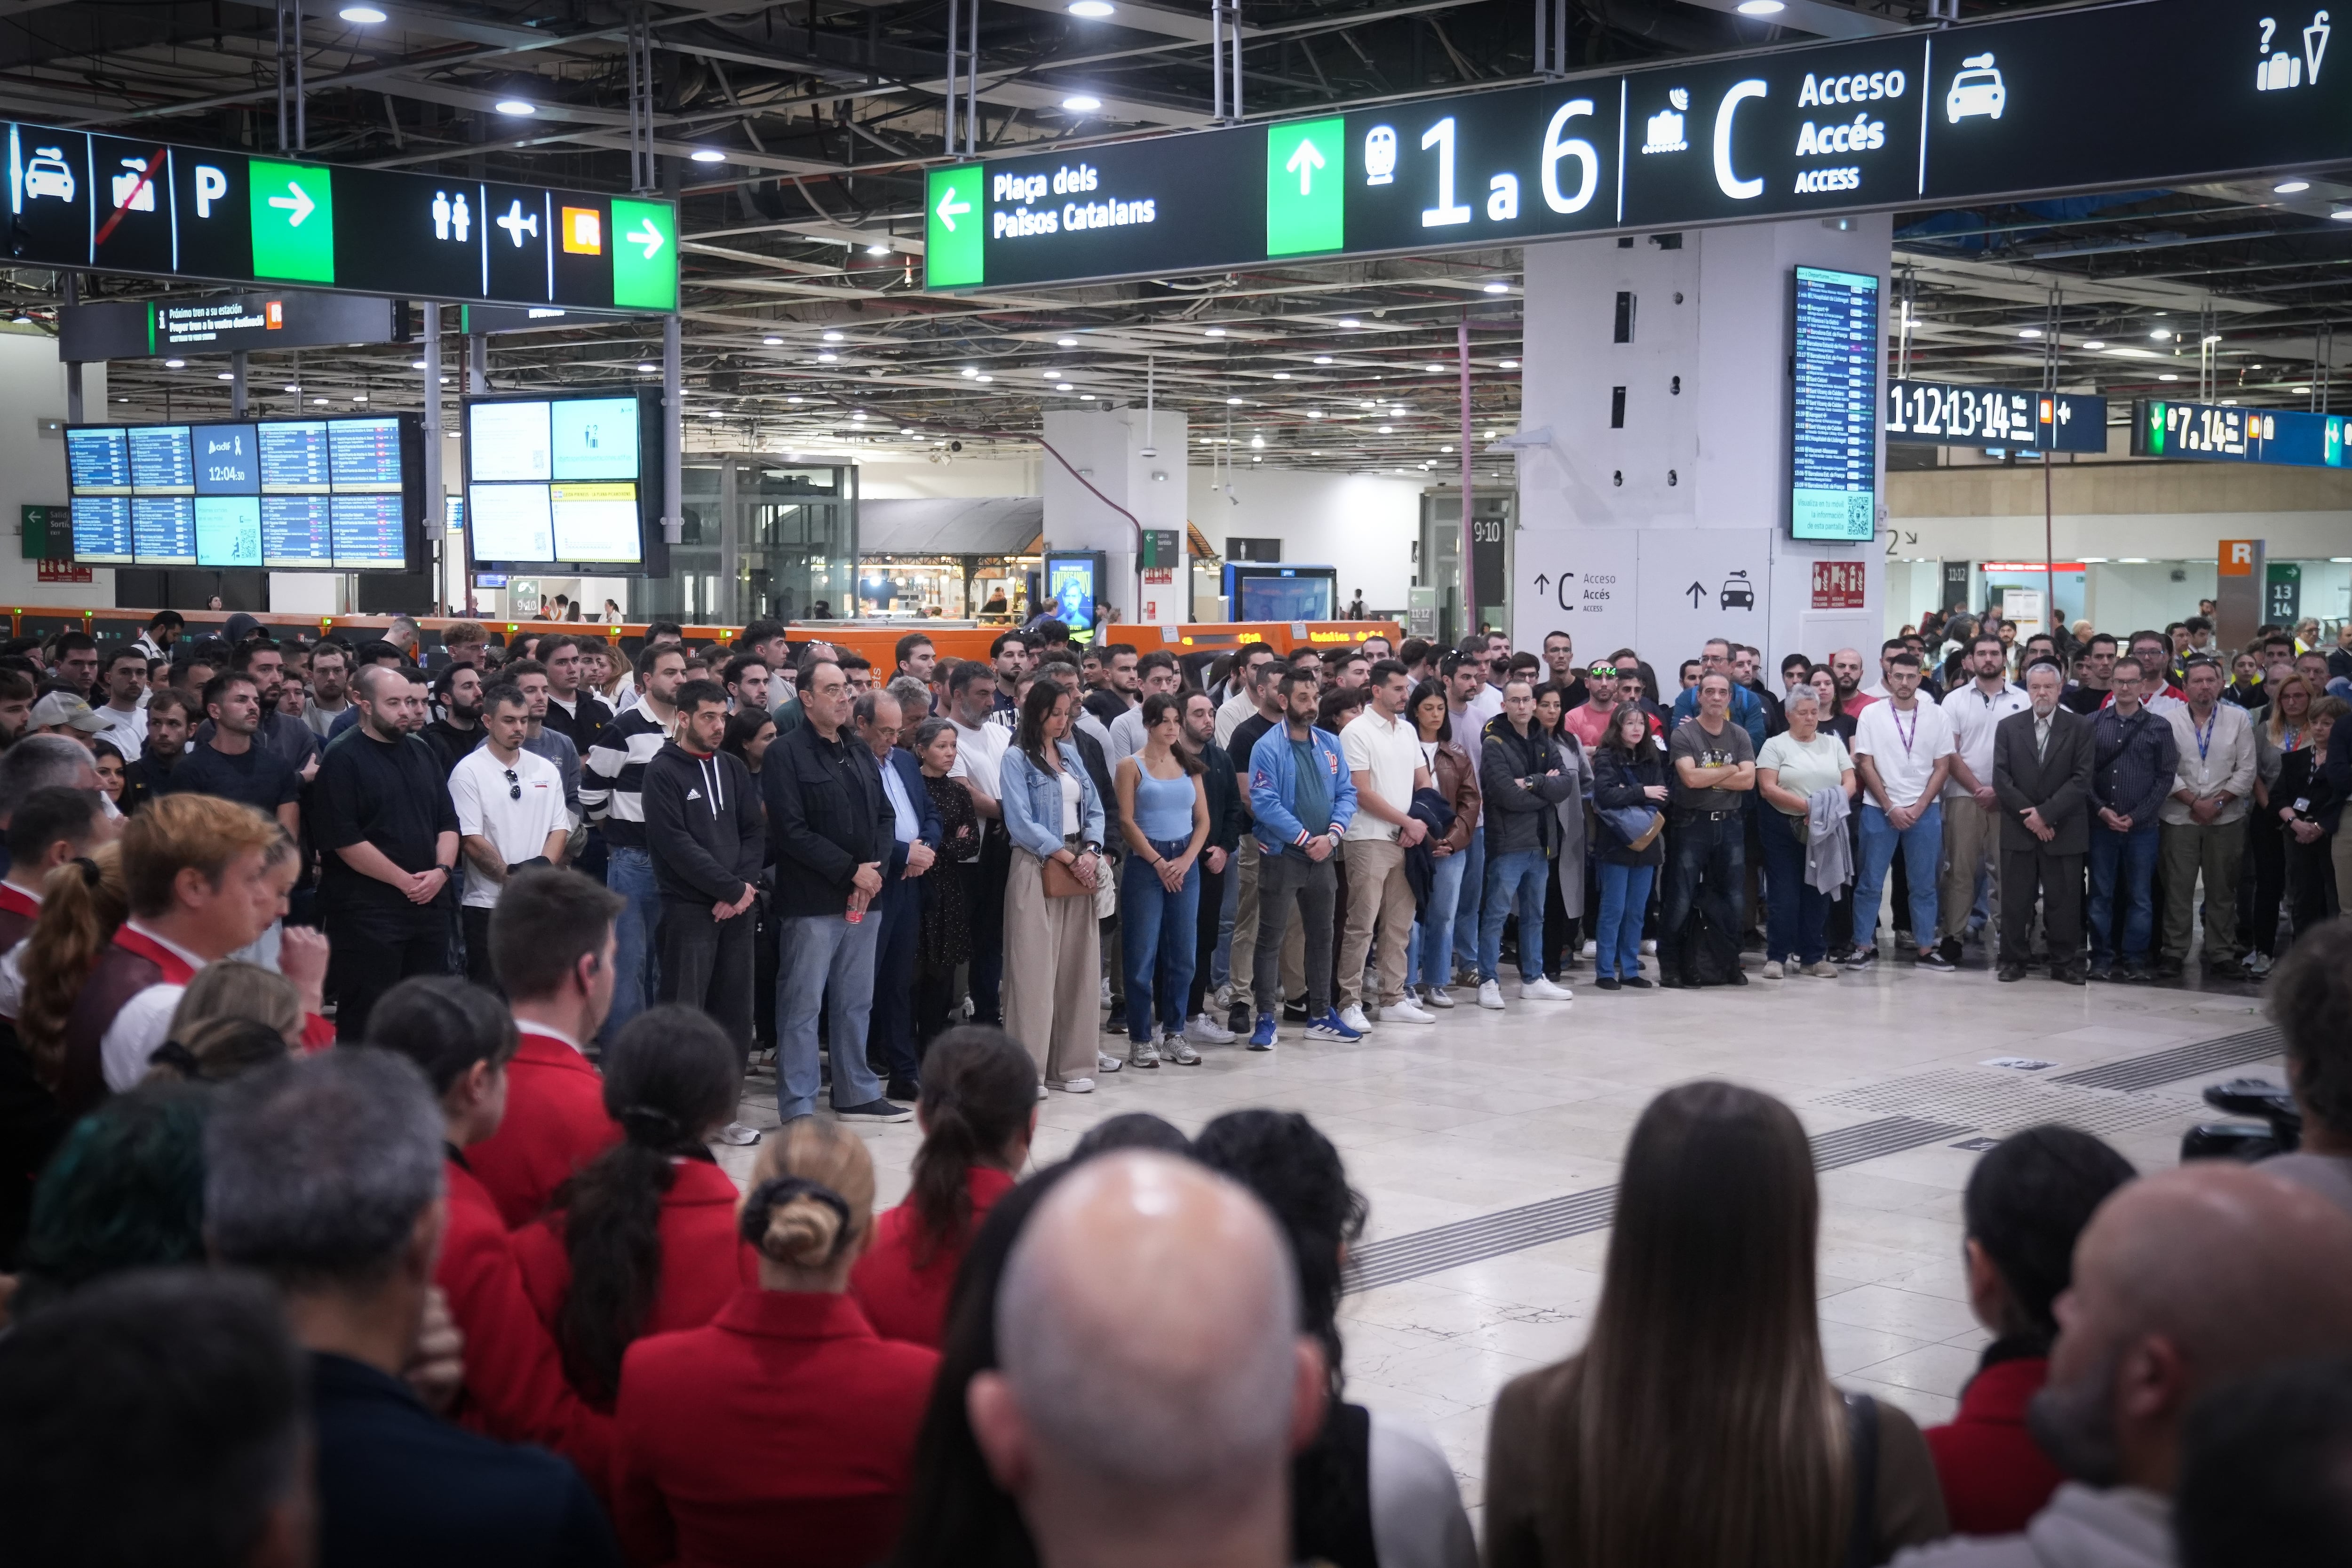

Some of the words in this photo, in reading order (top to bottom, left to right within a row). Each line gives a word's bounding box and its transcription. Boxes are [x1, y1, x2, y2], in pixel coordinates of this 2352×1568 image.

[1797, 70, 1905, 108] Acceso
[1713, 79, 1768, 199] C
[1795, 112, 1885, 156] Accés
[1421, 116, 1471, 228] 1
[1487, 172, 1518, 222] a
[1541, 99, 1598, 215] 6
[196, 166, 226, 218] P
[993, 173, 1047, 204] Plaça
[1053, 164, 1097, 195] dels
[1794, 167, 1860, 194] ACCESS
[574, 215, 600, 247] R
[993, 207, 1058, 239] Països
[1063, 198, 1155, 231] Catalans
[169, 307, 192, 319] Próximo
[193, 308, 205, 318] tren
[218, 303, 242, 316] estación
[169, 321, 189, 334] Proper
[189, 321, 202, 331] tren
[202, 322, 207, 330] a
[207, 319, 214, 330] la
[214, 318, 233, 329] vostra
[233, 314, 264, 328] destinació
[271, 304, 282, 322] R
[2178, 407, 2193, 449] 7
[2190, 430, 2199, 450] a
[2200, 409, 2226, 452] 14
[216, 442, 231, 451] adif
[209, 467, 245, 481] 12:04:30
[1885, 529, 1899, 555] 2
[2232, 543, 2251, 564] R
[1558, 573, 1574, 611] C
[1583, 573, 1616, 584] Acceso
[1583, 589, 1610, 600] Accés
[2273, 584, 2292, 599] 13
[2273, 602, 2292, 617] 14
[1311, 632, 1350, 642] Rodalies
